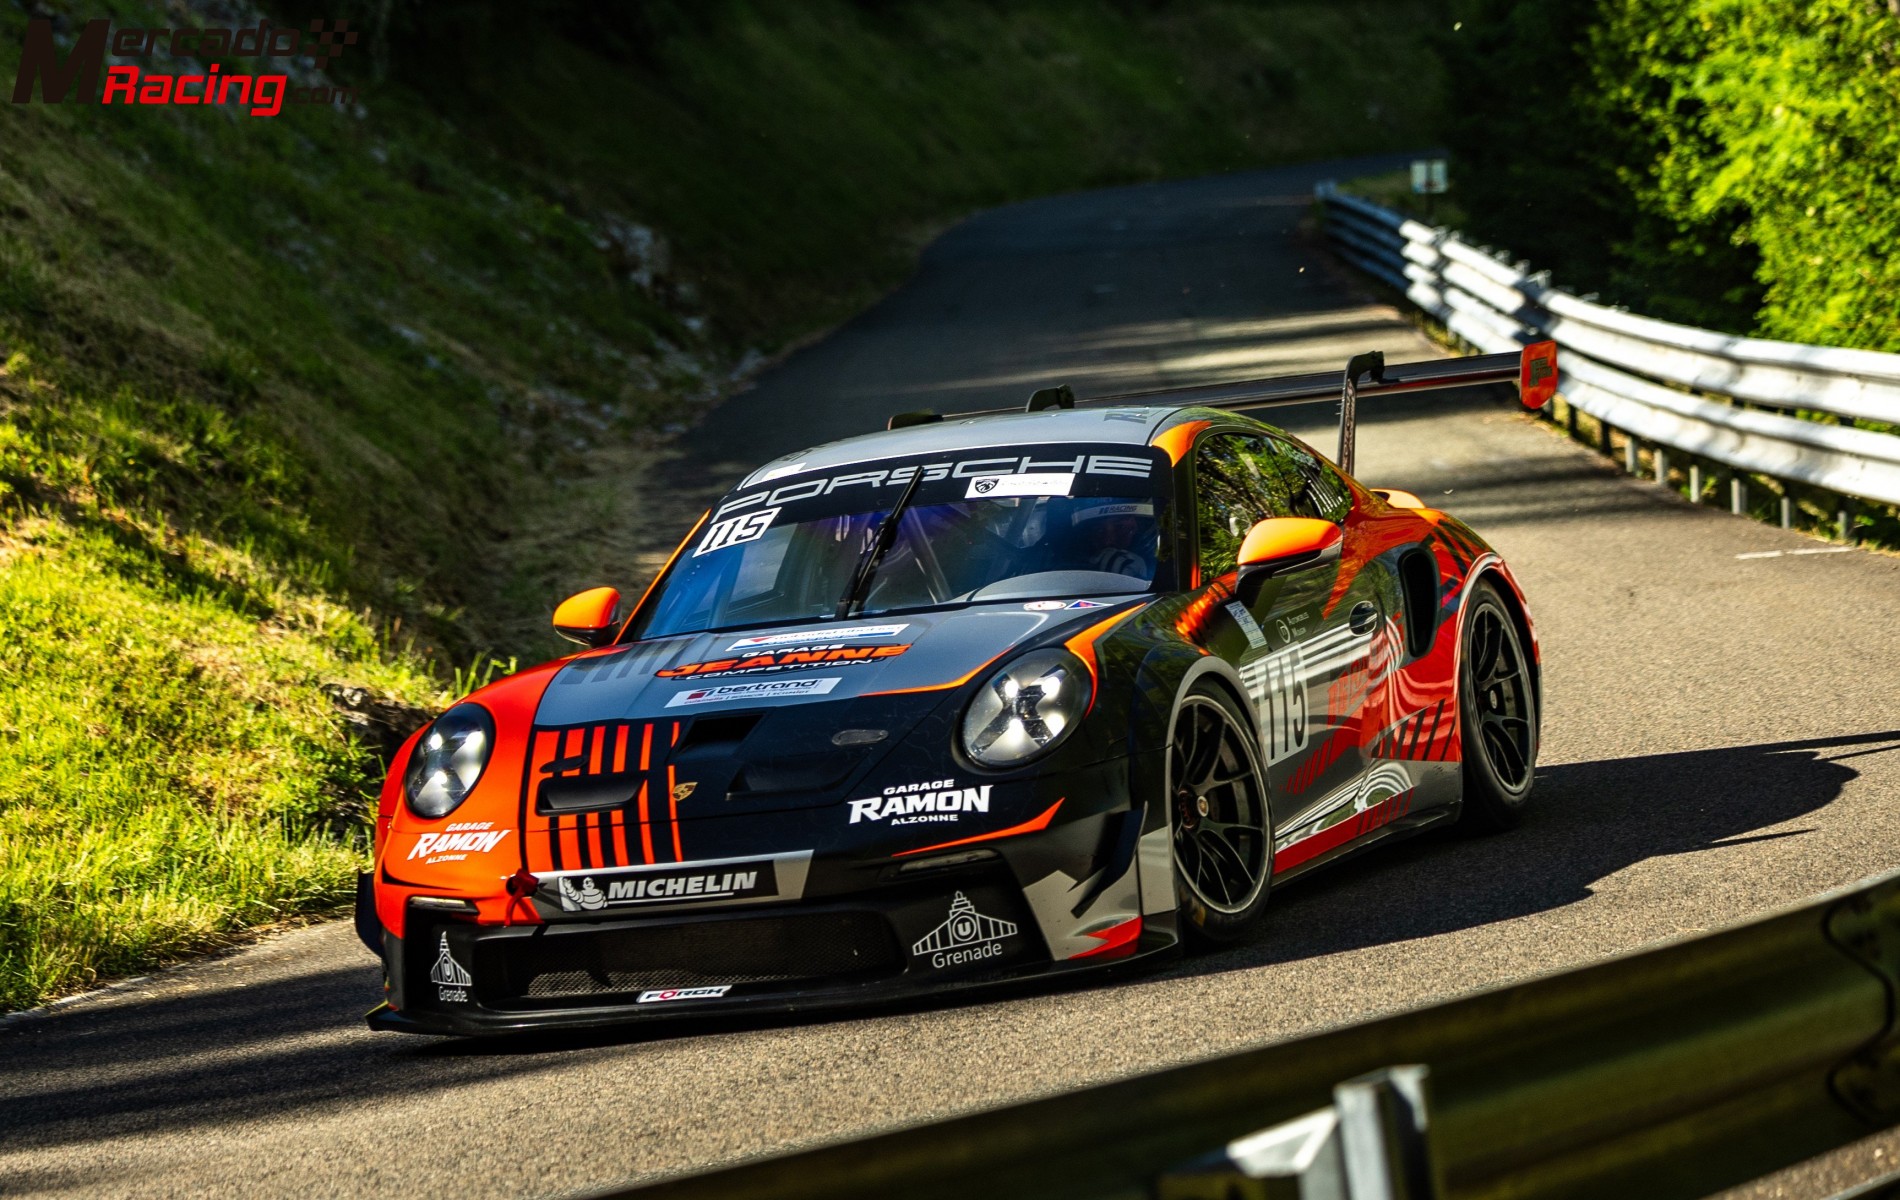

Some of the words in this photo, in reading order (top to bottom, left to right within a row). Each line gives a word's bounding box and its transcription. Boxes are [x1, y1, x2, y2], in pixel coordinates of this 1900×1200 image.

[710, 455, 1153, 524] PORSCHE
[701, 511, 774, 552] 115
[656, 644, 912, 678] JEANNE
[742, 644, 845, 658] GARAGE
[686, 659, 873, 680] COMPETITION
[718, 680, 818, 694] bertrand
[1263, 652, 1306, 760] 115
[883, 779, 955, 795] GARAGE
[847, 785, 994, 824] RAMON
[445, 822, 495, 832] GARAGE
[891, 814, 959, 825] ALZONNE
[407, 830, 512, 860] RAMON
[425, 854, 468, 864] ALZONNE
[608, 871, 758, 899] MICHELIN
[932, 941, 1003, 968] Grenade
[439, 986, 468, 1002] Grenade
